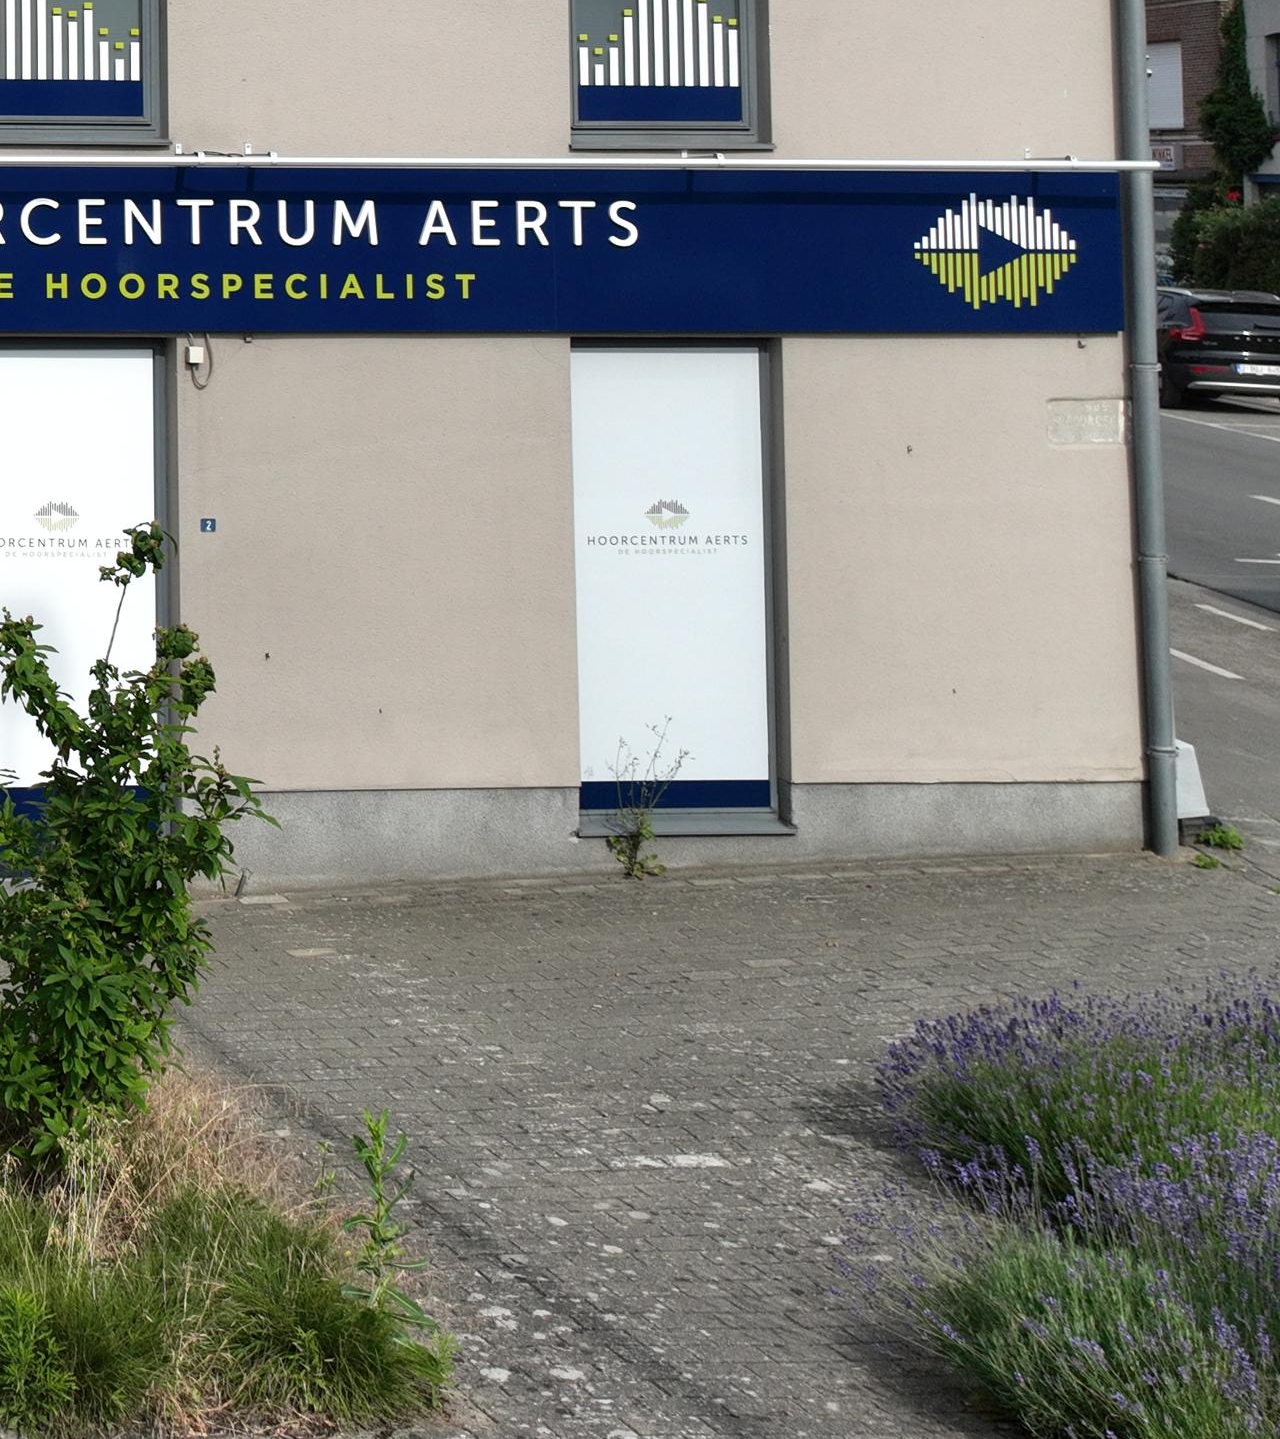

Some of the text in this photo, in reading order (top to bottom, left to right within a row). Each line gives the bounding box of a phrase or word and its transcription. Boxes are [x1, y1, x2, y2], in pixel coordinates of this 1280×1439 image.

[418, 200, 641, 248] AERTS
[45, 272, 477, 301] HOORSPECIALIST
[205, 520, 212, 531] 2
[95, 538, 131, 549] AERT
[587, 535, 749, 546] HOORCENTRUM AERTS
[22, 550, 108, 558] HOORSPECIALIST
